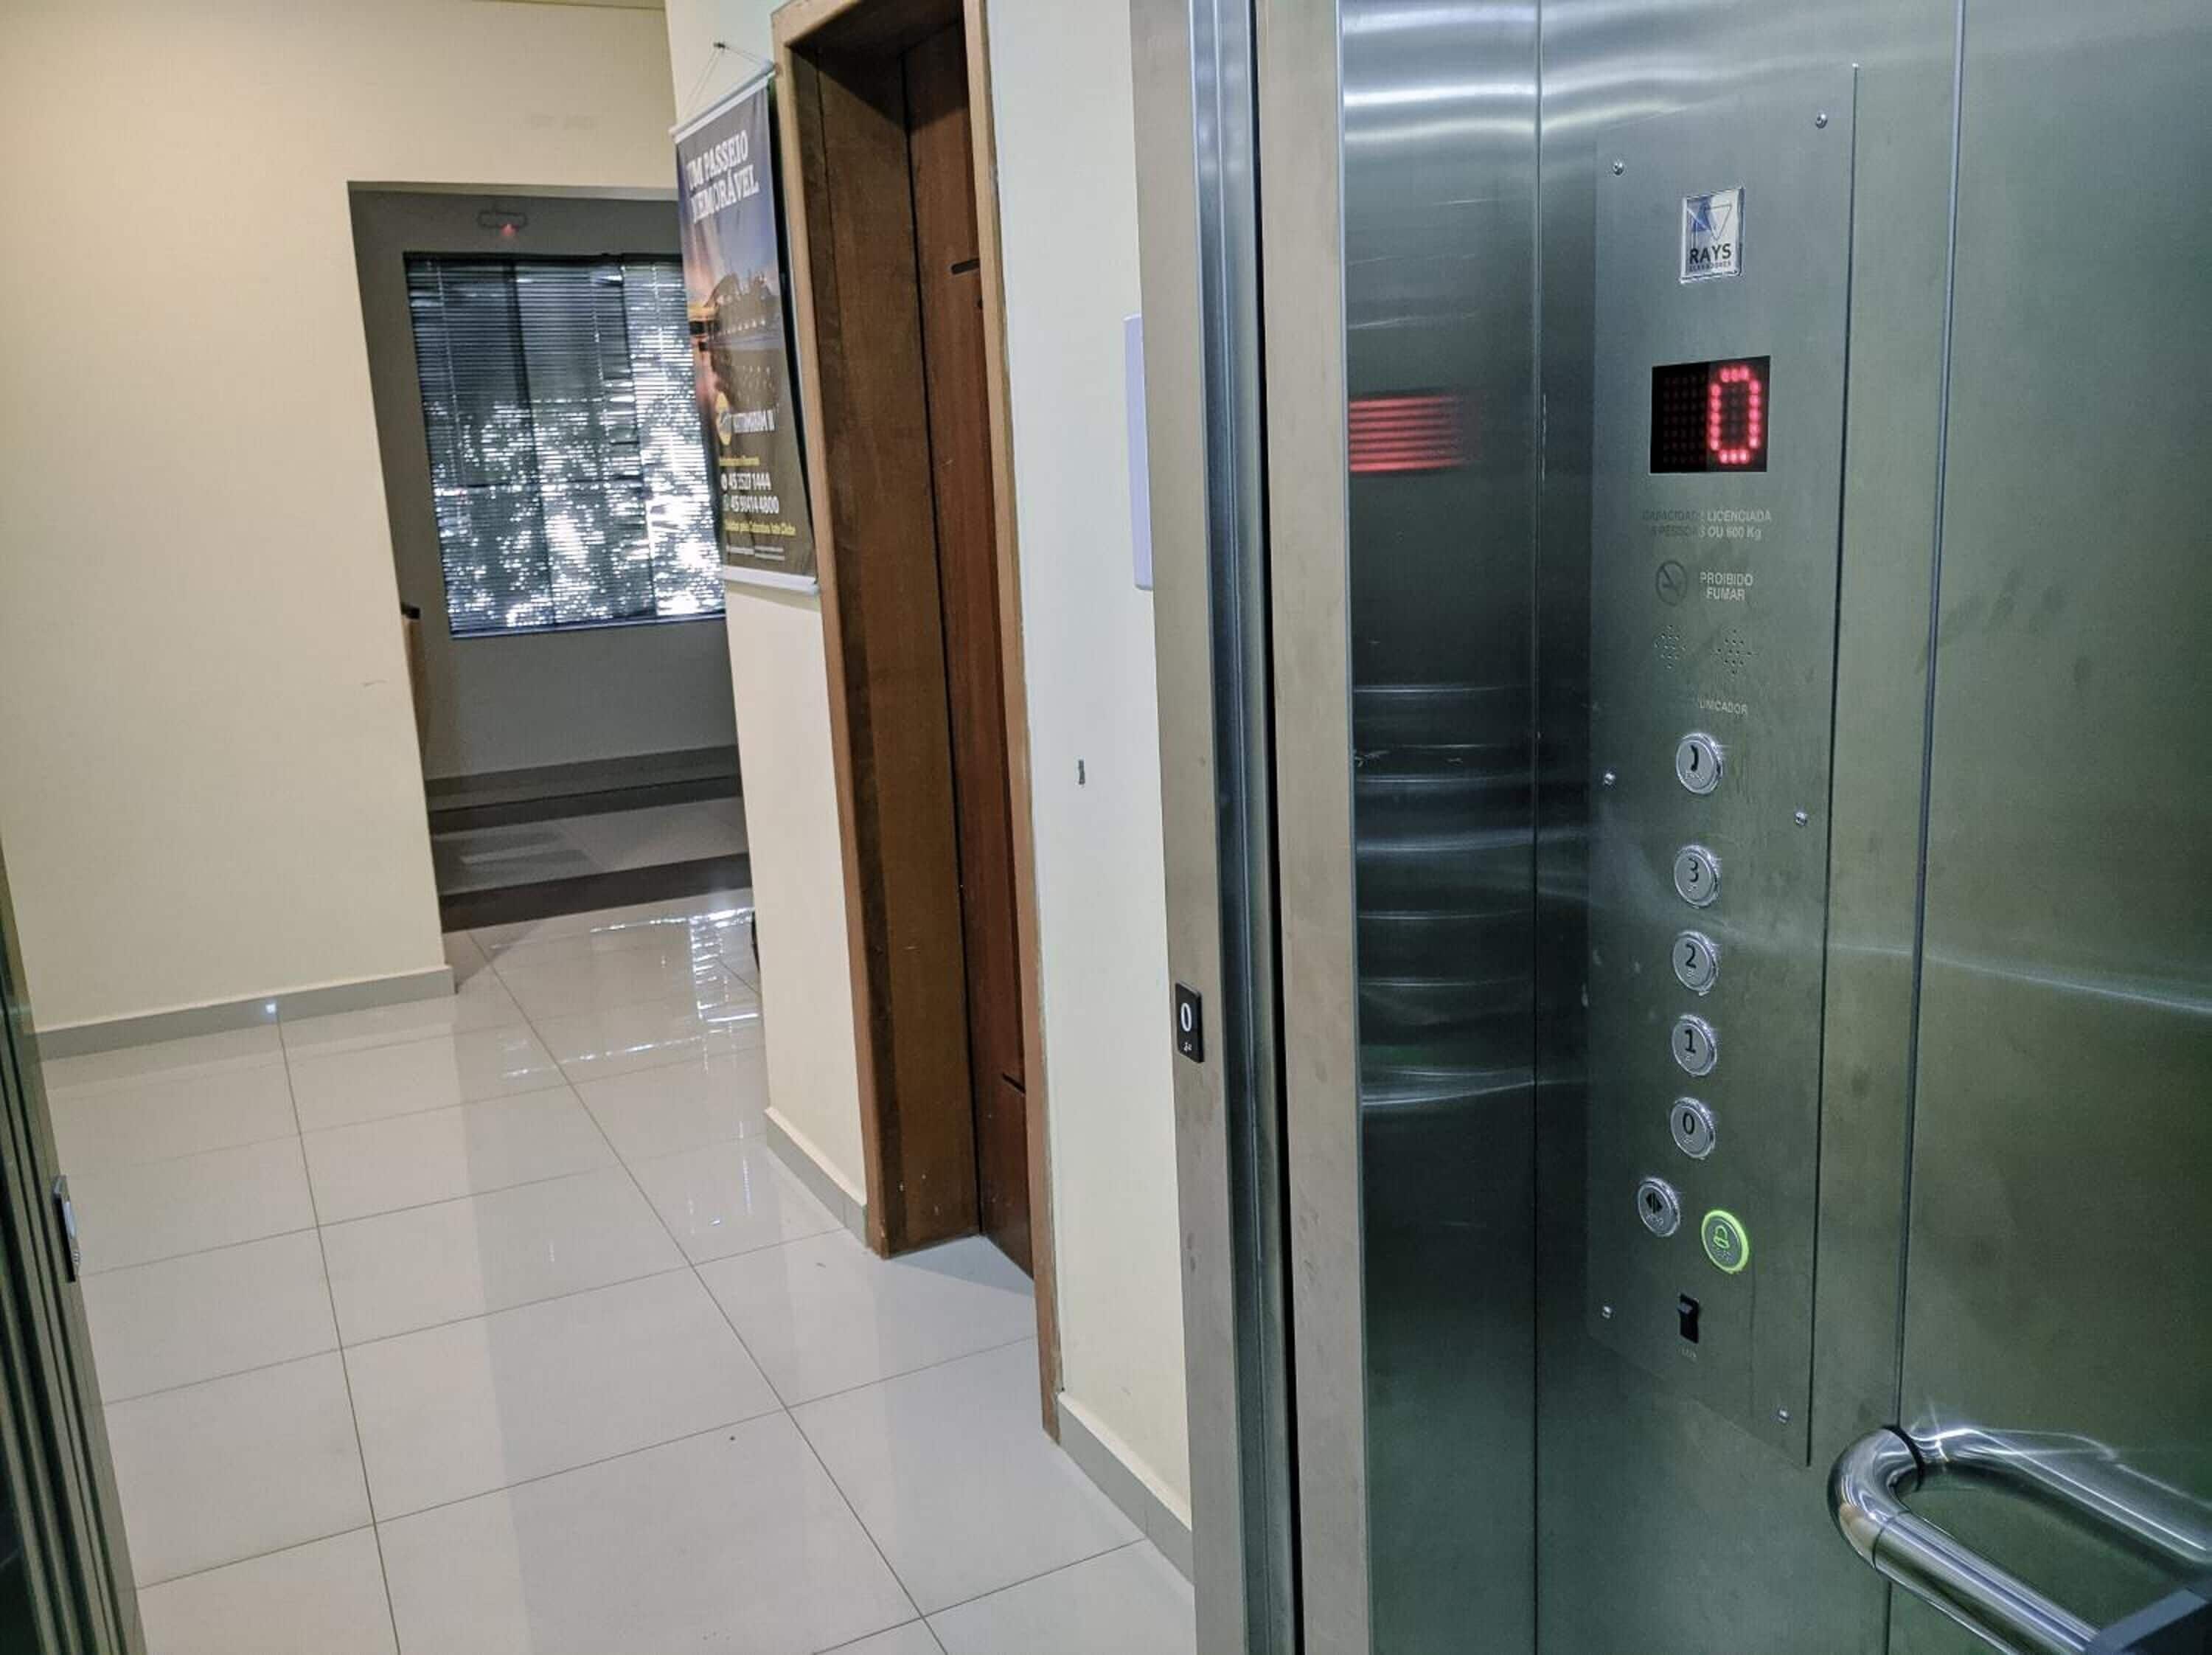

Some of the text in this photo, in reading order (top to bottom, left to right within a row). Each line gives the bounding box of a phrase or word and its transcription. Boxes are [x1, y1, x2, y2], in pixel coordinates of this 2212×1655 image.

[703, 129, 749, 181] PASSEIO
[691, 164, 760, 223] MEMORÁVEL
[1689, 243, 1732, 265] RAYS
[1710, 363, 1761, 466] 0
[1706, 509, 1772, 522] LICENCIADA
[1707, 524, 1724, 538] OU
[1746, 526, 1763, 541] Kg
[1700, 572, 1754, 587] PROIBIDO
[1705, 587, 1747, 601] FUMAR
[1688, 857, 1700, 884] 3
[1685, 943, 1697, 969] 2
[1180, 1002, 1192, 1033] 0
[1684, 1029, 1697, 1054] 1
[1682, 1112, 1695, 1136] 0
